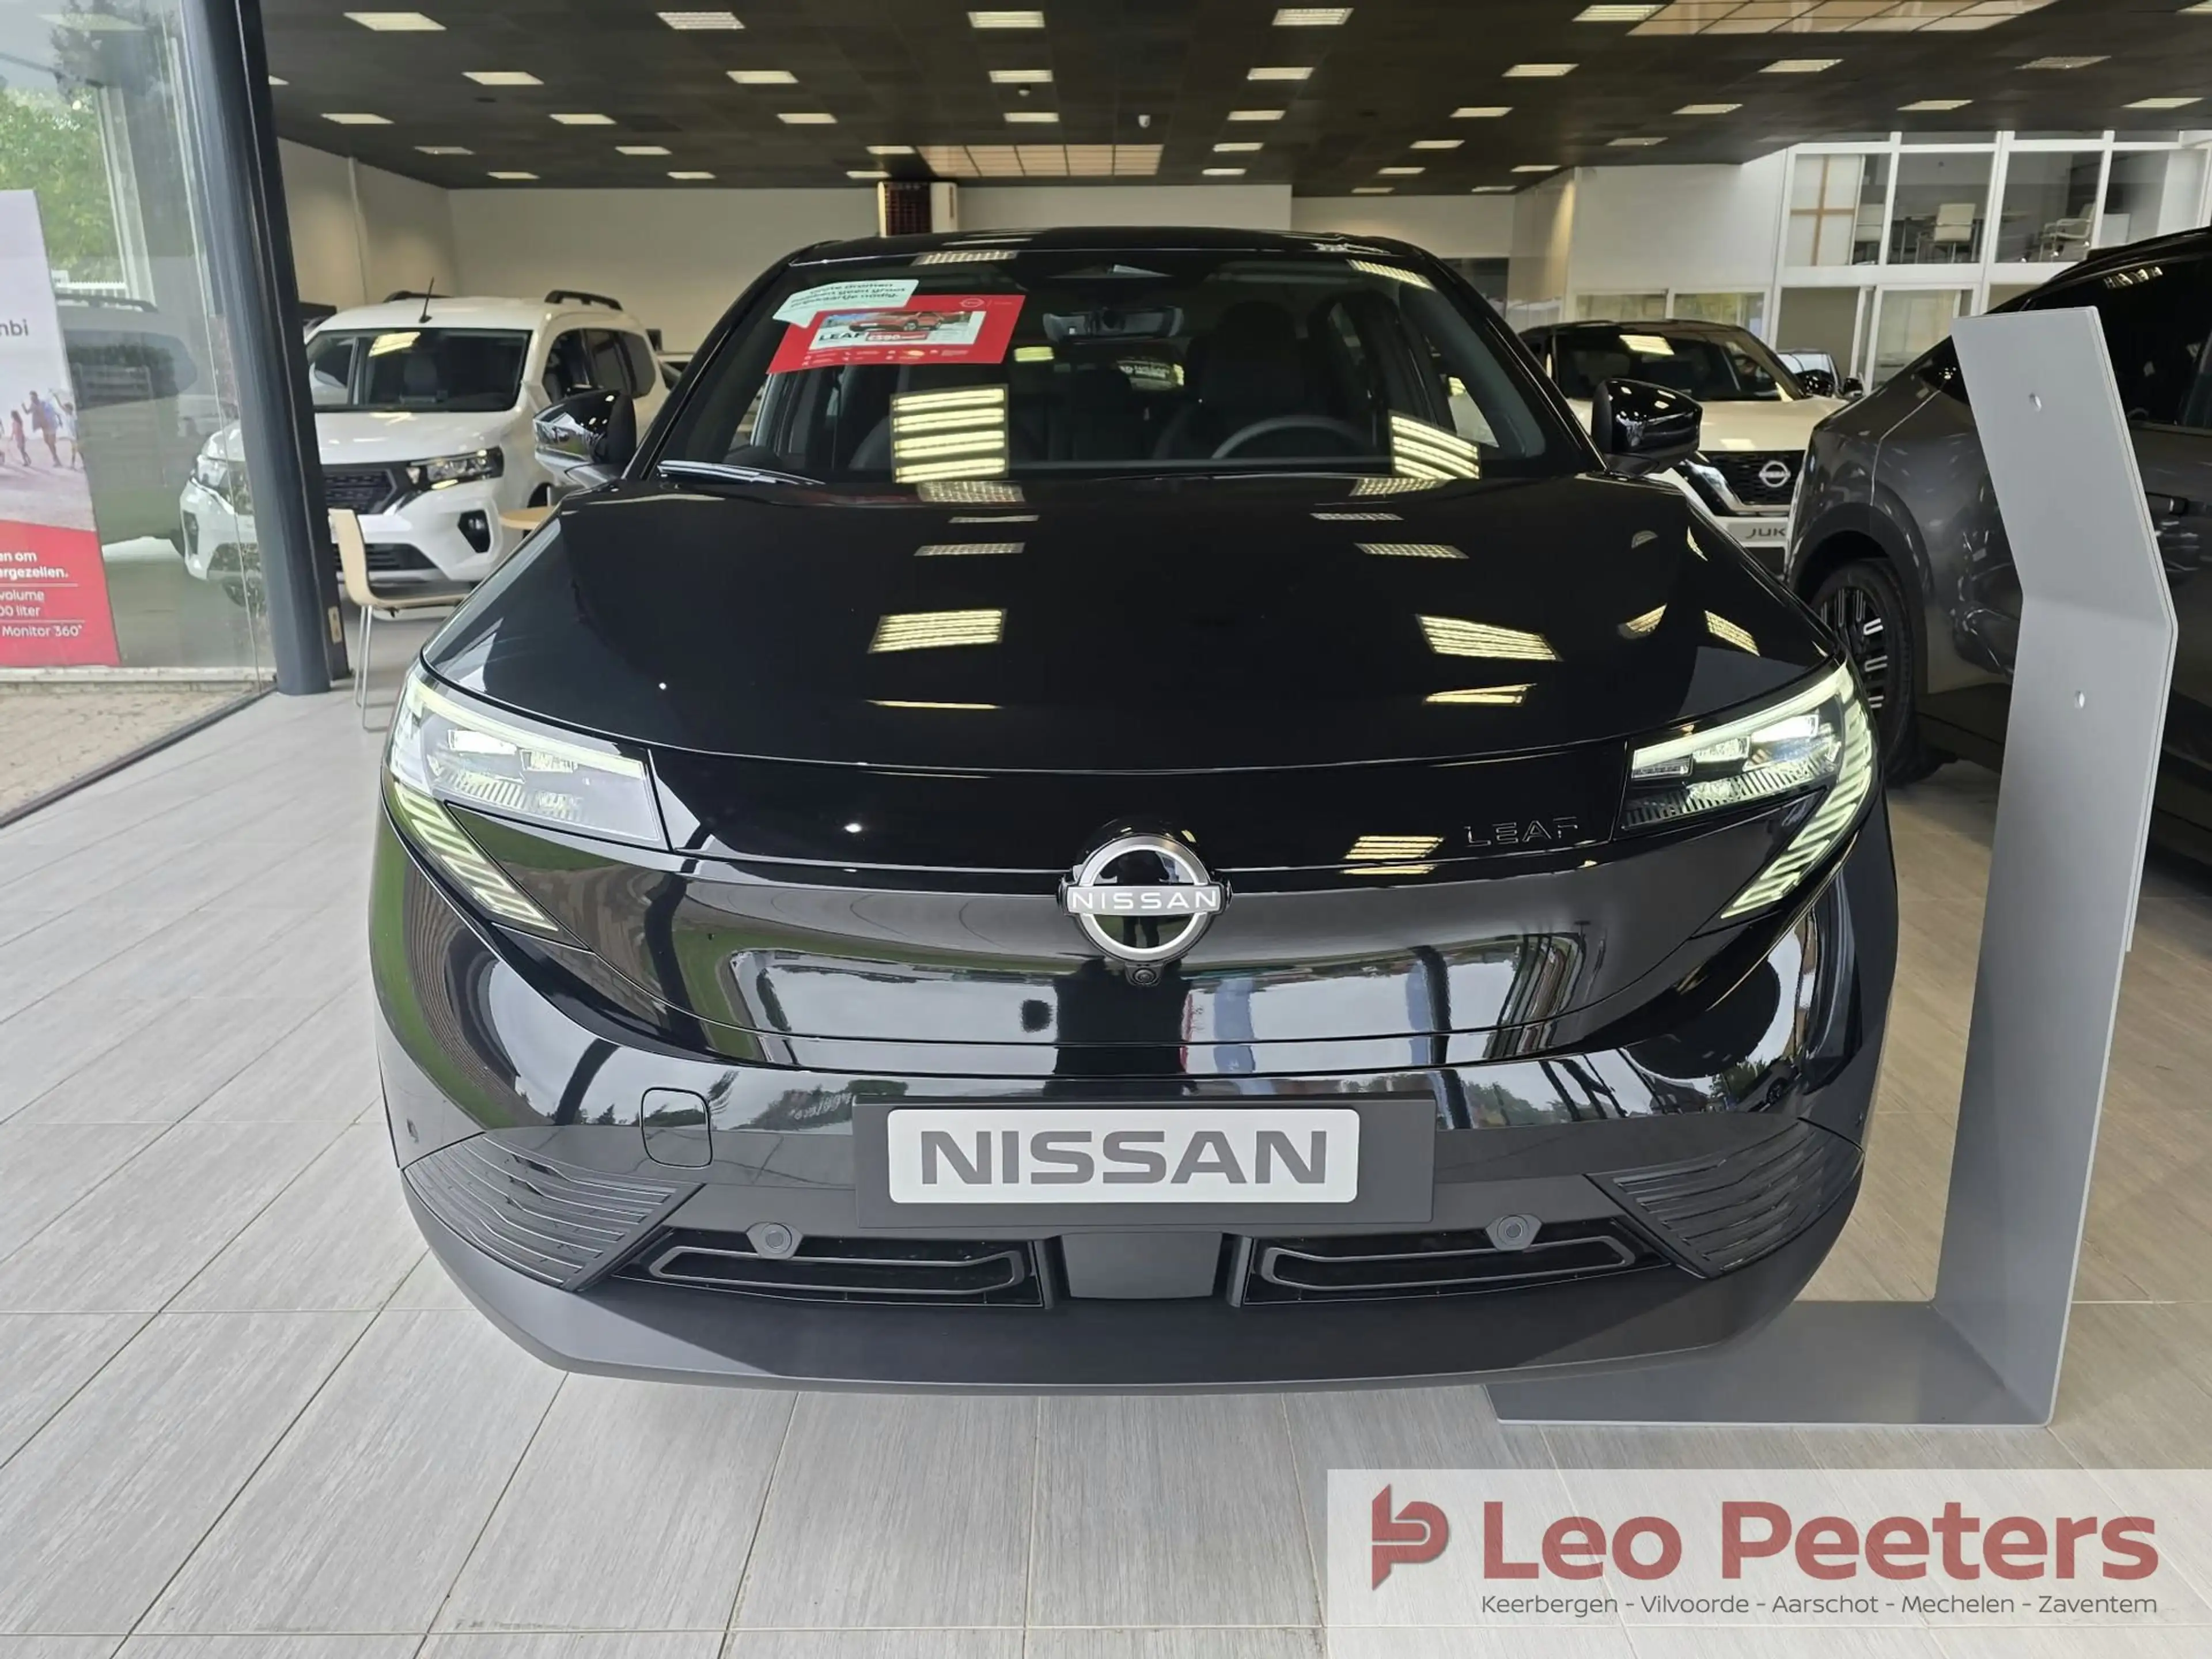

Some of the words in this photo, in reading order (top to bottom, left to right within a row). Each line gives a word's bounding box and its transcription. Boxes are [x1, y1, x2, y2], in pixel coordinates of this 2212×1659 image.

[14, 552, 37, 562] om
[16, 605, 40, 616] liter
[2, 625, 51, 637] Monitor
[1464, 816, 1578, 847] LEAF
[1072, 890, 1215, 910] NISSAN
[921, 1130, 1327, 1185] NISSAN
